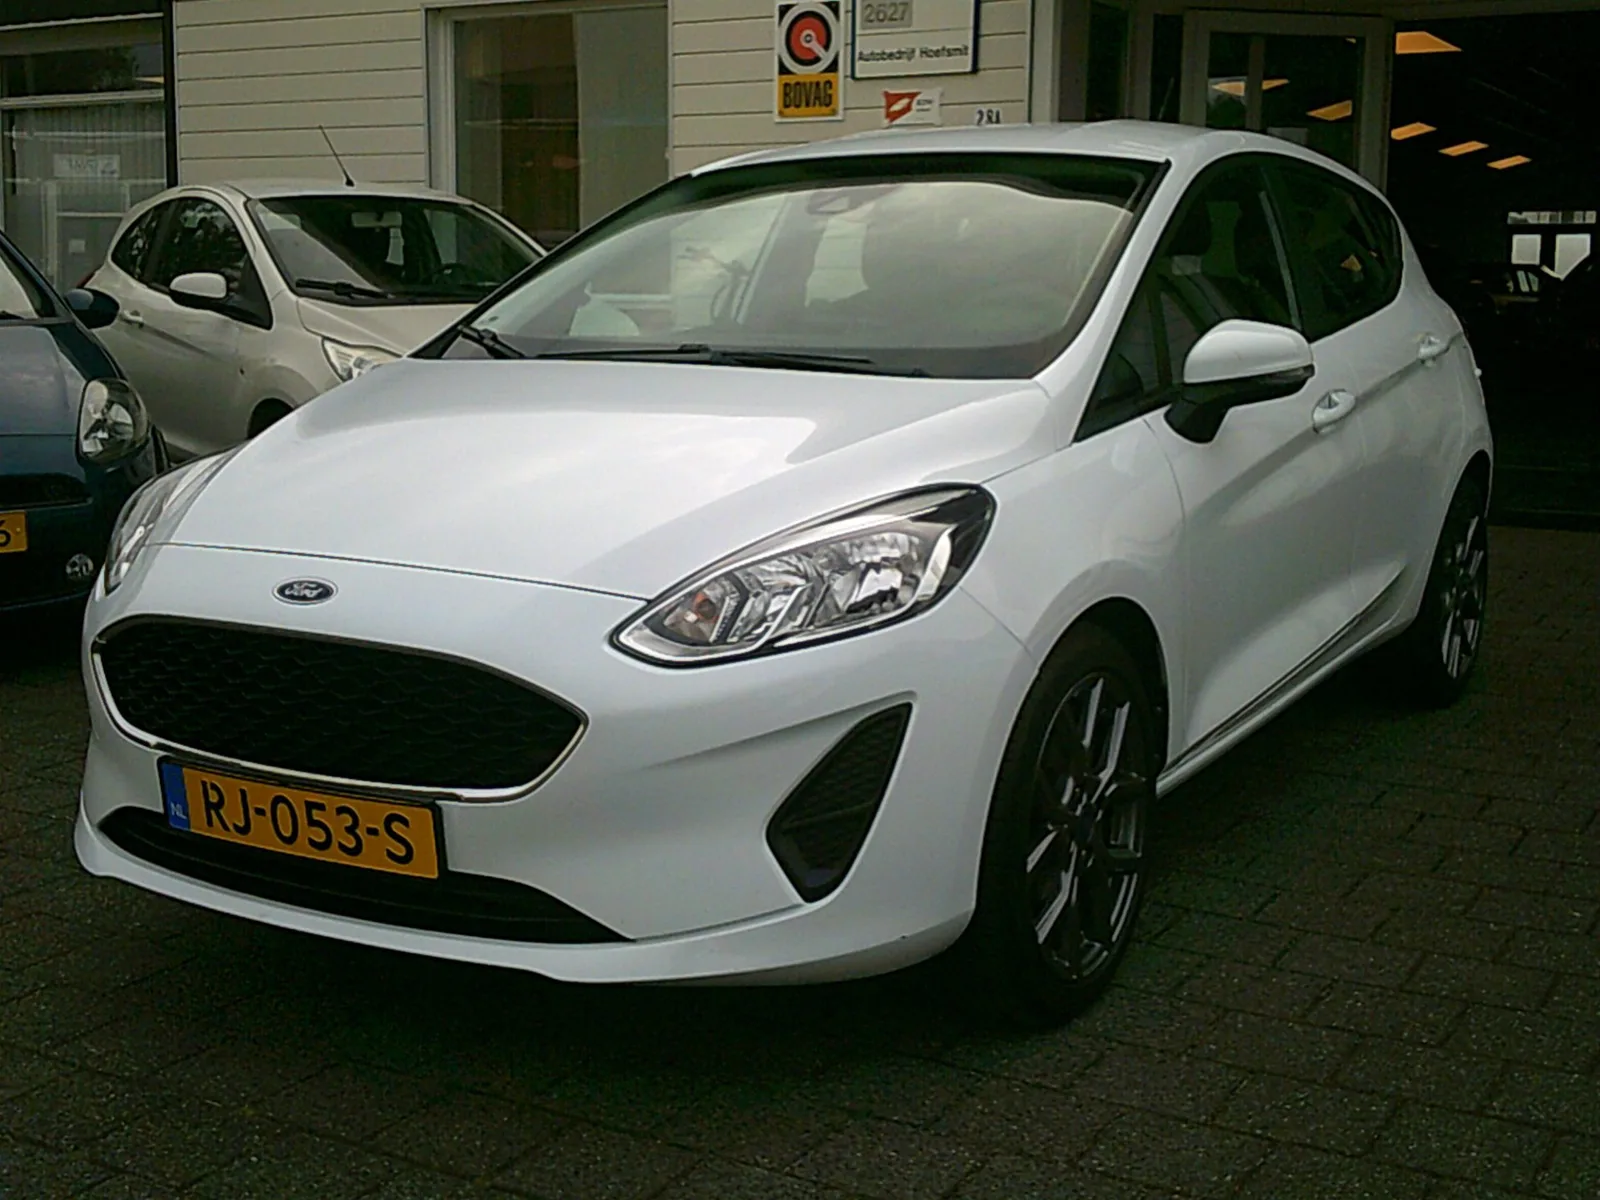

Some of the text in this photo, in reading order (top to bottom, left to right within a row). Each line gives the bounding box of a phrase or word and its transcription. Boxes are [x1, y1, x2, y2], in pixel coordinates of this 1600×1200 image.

[863, 2, 909, 23] 2627
[857, 47, 916, 63] Autobedrijf
[783, 80, 833, 109] BOVAG
[284, 582, 323, 599] Ford
[170, 802, 188, 820] NL
[201, 780, 415, 865] RJ-053-S
